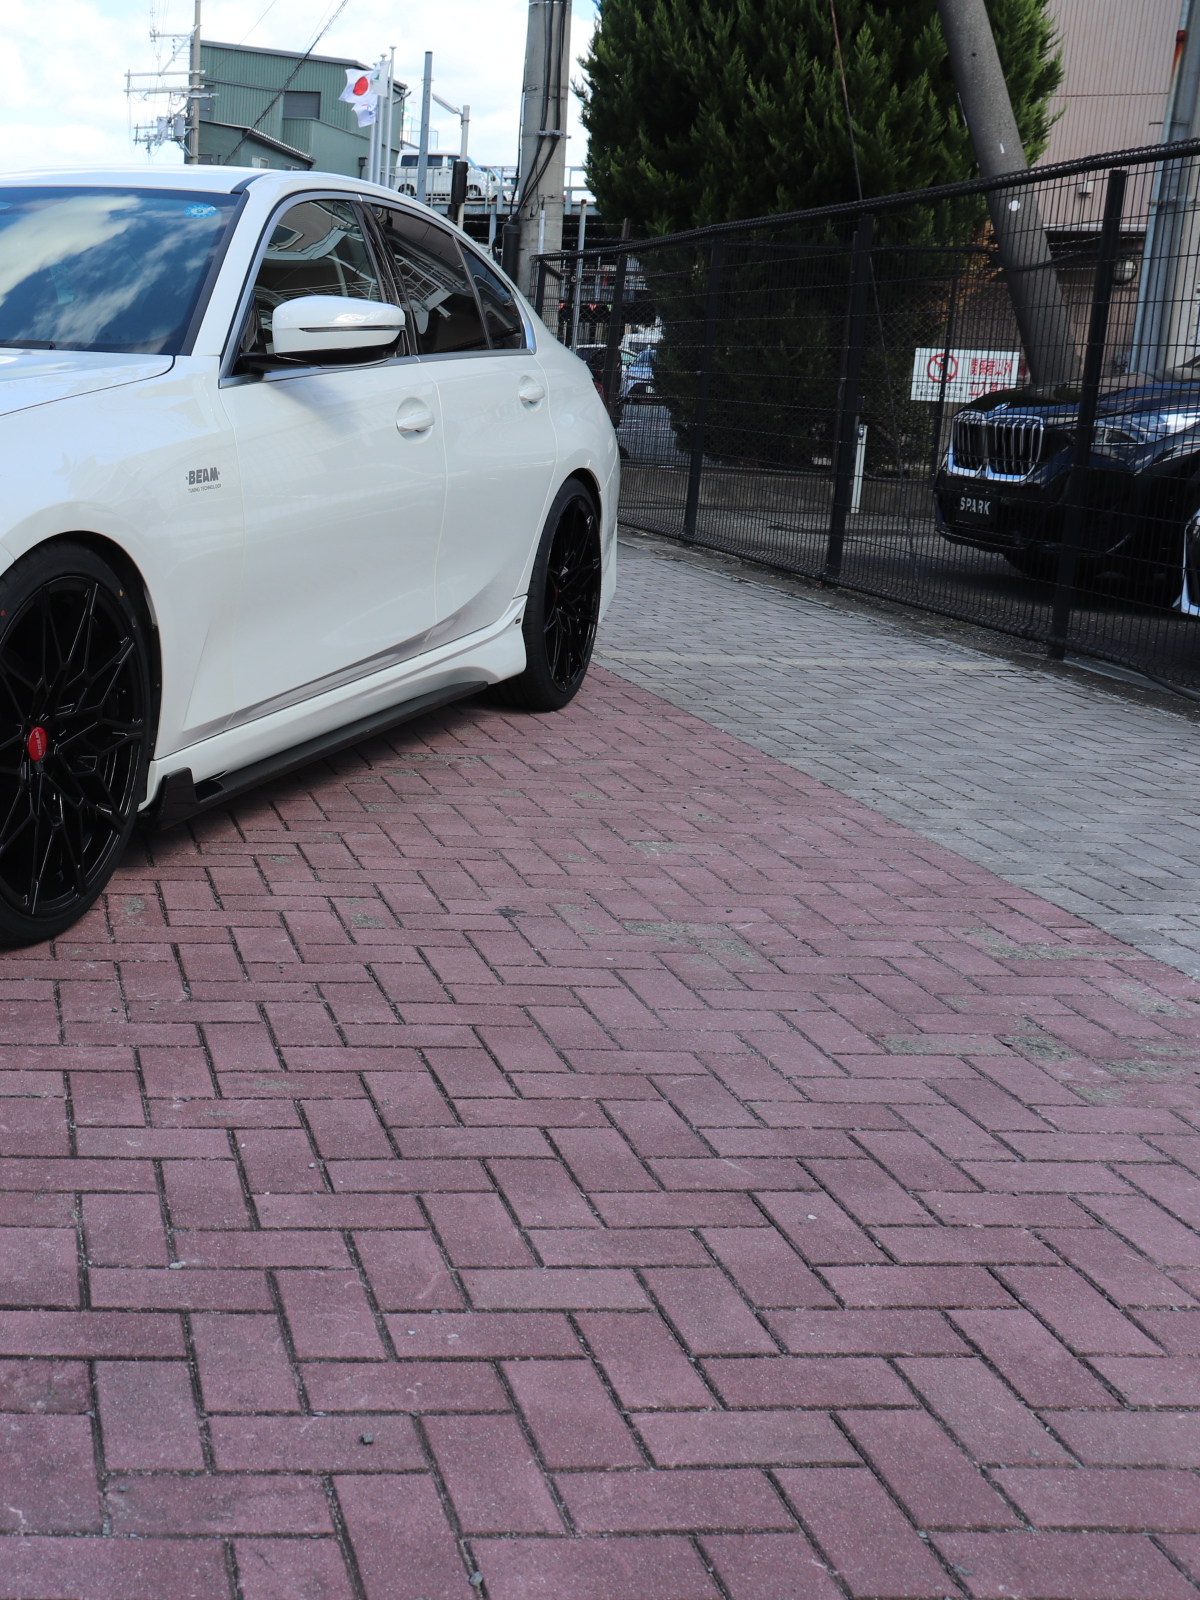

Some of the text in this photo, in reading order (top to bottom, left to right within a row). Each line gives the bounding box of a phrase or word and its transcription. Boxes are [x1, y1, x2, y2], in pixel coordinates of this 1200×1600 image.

[968, 380, 1011, 397] 立入禁
[187, 466, 220, 485] BEAM
[960, 496, 991, 515] SPARK
